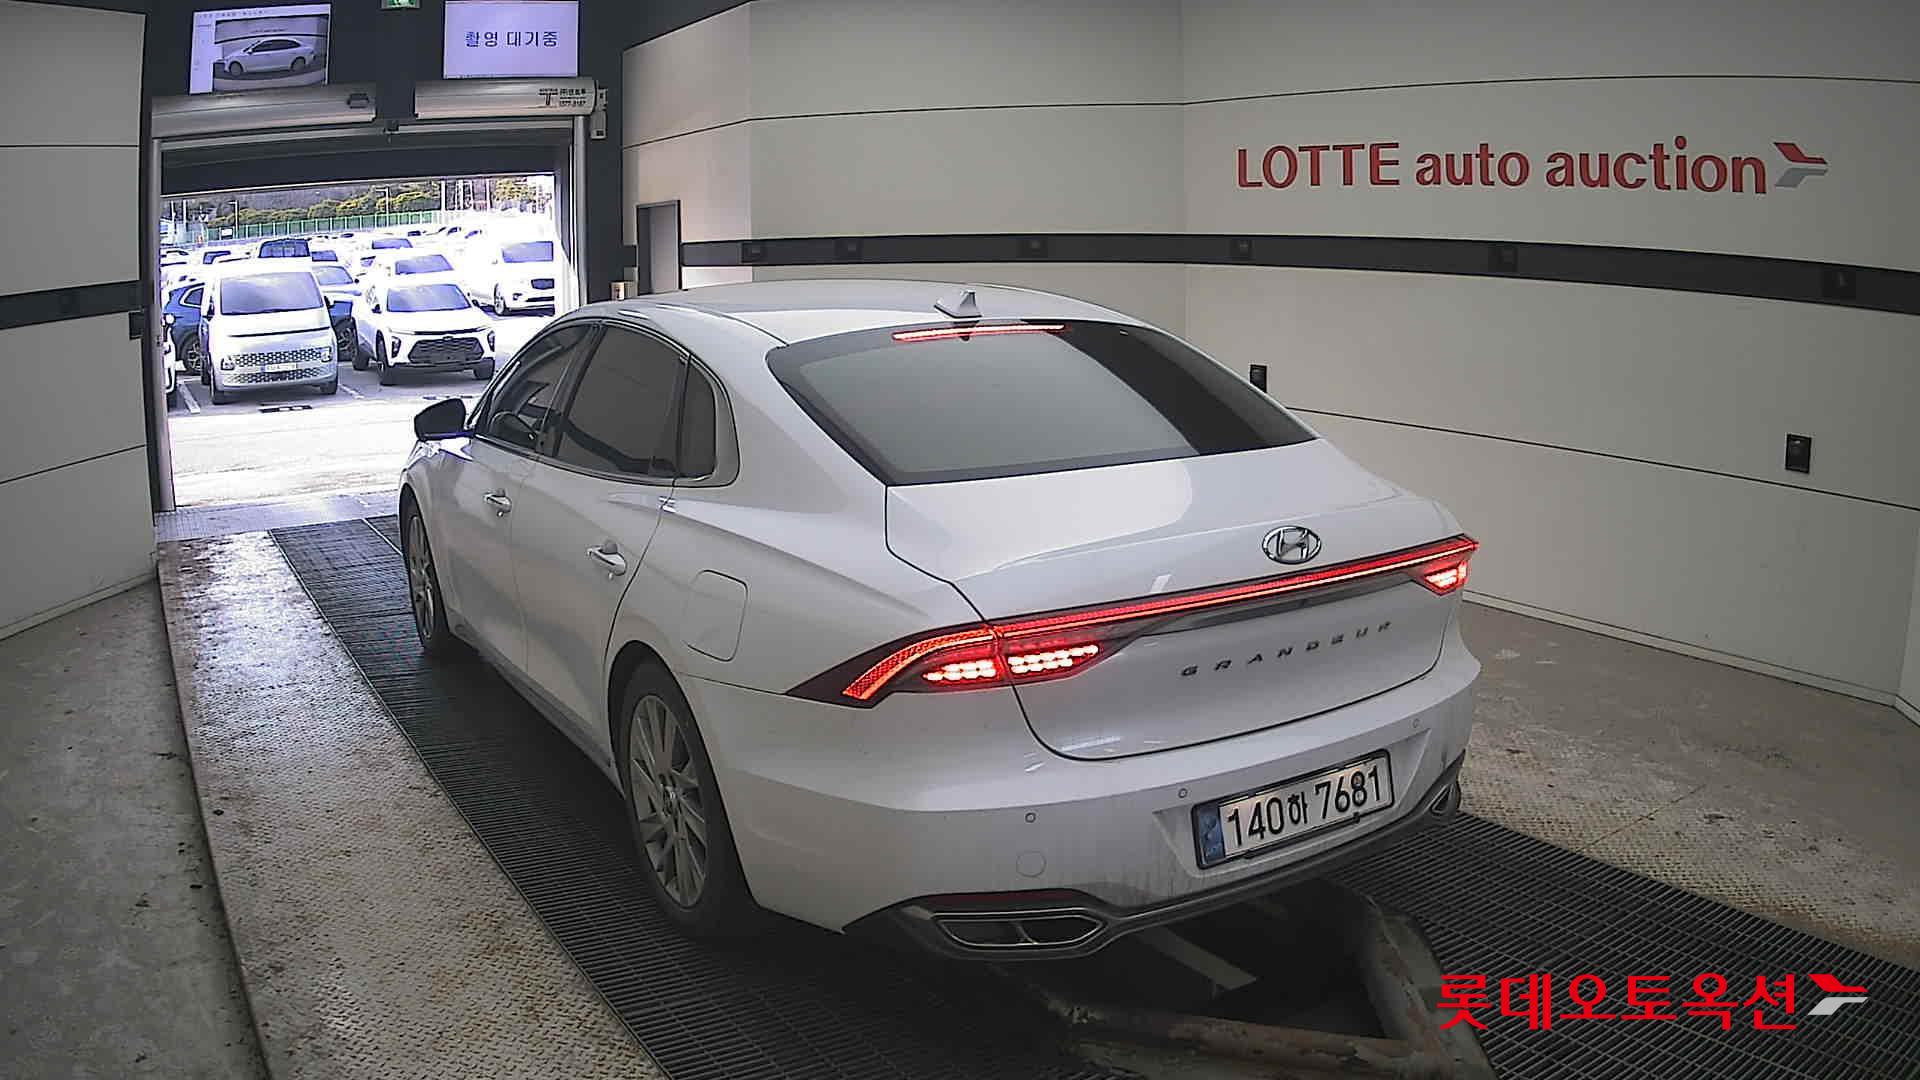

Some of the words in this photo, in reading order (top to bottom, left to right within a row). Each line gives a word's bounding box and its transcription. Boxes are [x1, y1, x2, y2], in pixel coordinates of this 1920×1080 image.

[506, 31, 558, 48] 대기중
[1237, 142, 1400, 188] LOTTE
[1415, 143, 1531, 187] auto
[1546, 135, 1767, 194] auction
[1181, 621, 1391, 677] GRANDEUR
[1227, 790, 1308, 847] 140하
[1315, 765, 1382, 820] 7681
